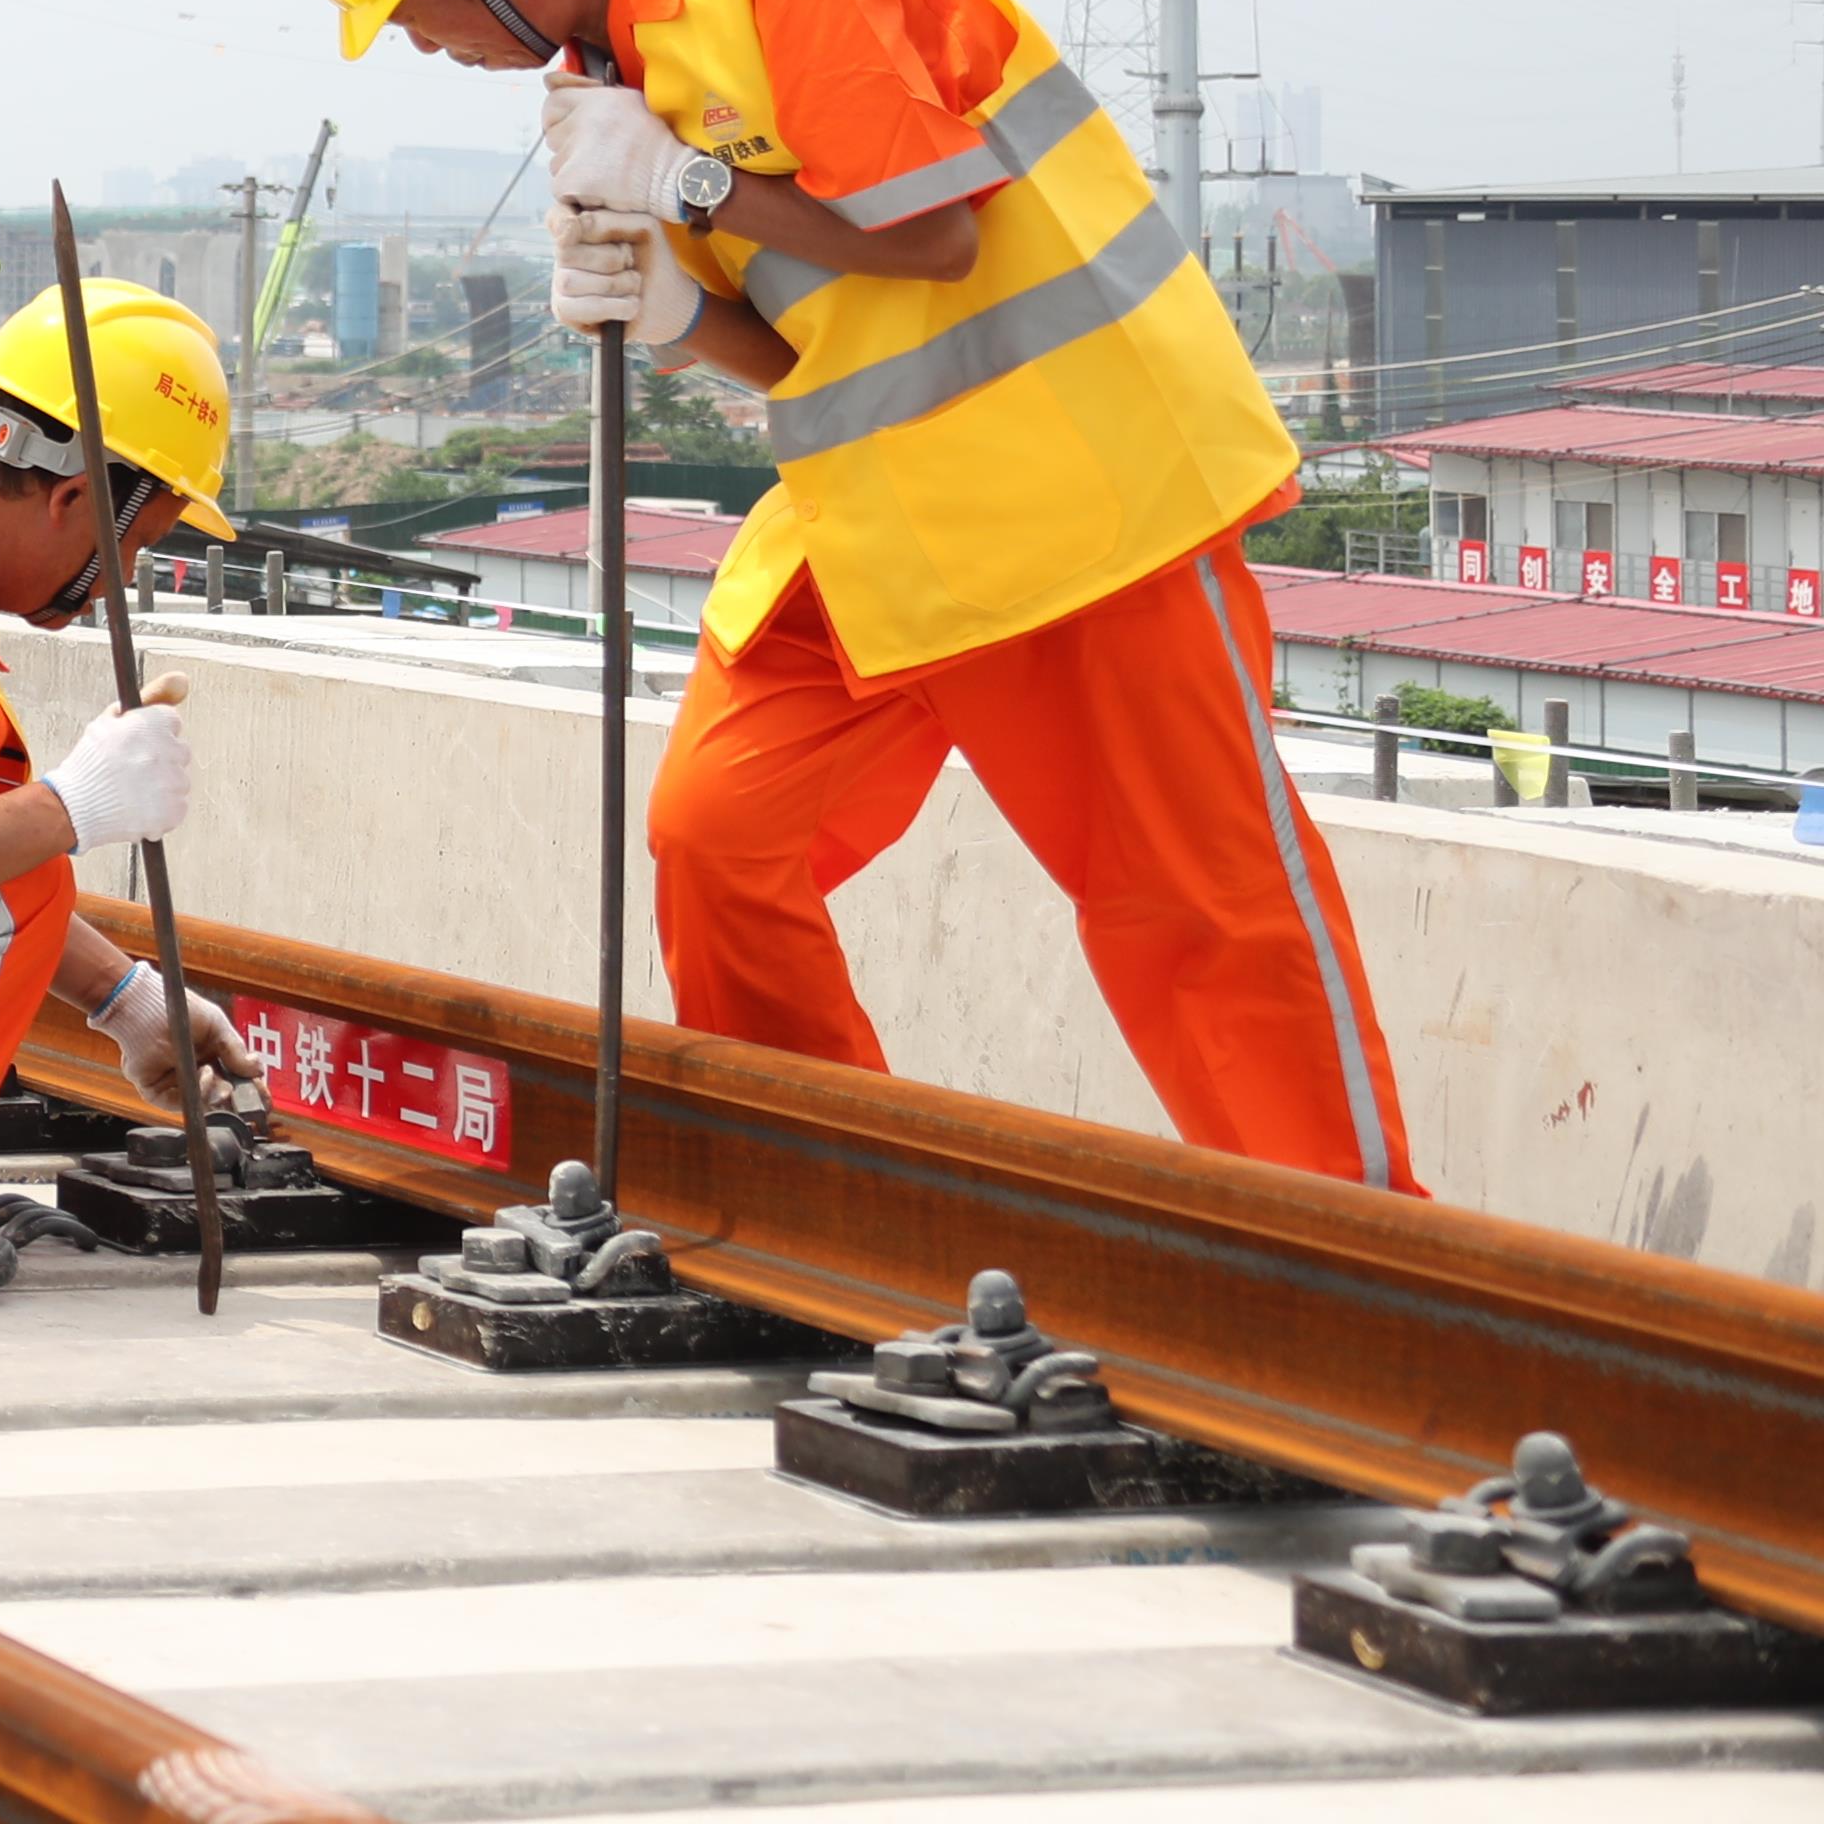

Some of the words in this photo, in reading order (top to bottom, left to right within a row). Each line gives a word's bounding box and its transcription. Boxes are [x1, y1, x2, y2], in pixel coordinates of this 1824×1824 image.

[1461, 549, 1815, 615] 同创安全工地
[248, 1011, 496, 1154] 中铁十二局
